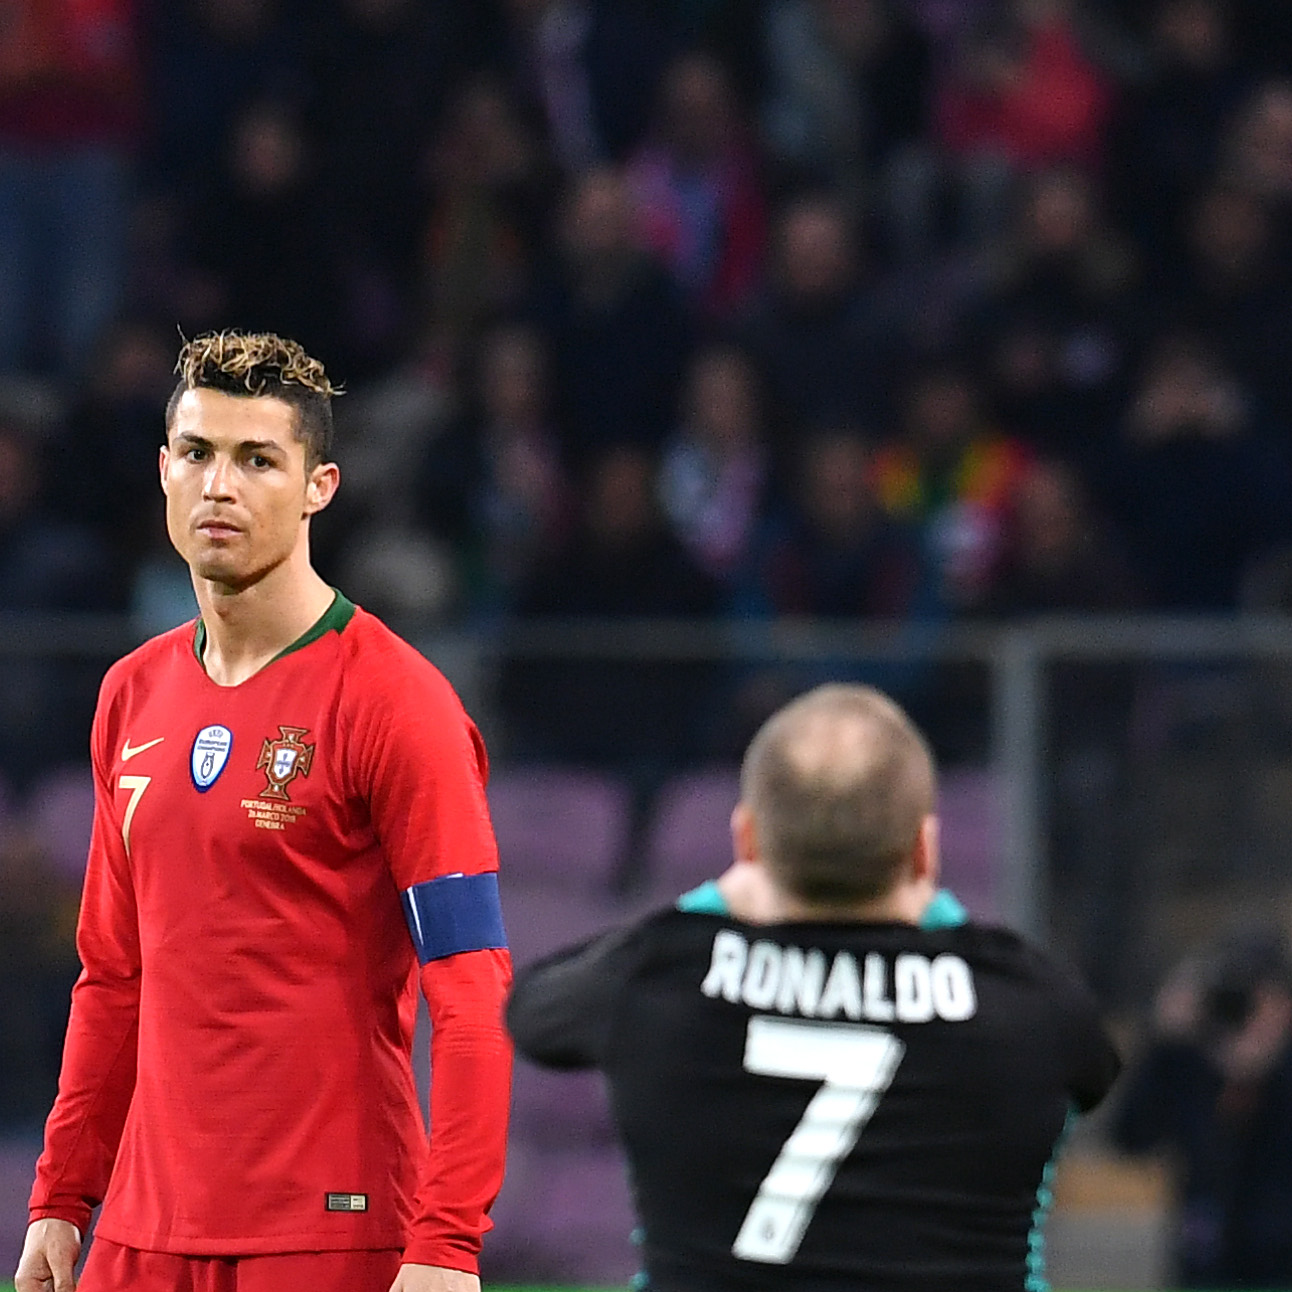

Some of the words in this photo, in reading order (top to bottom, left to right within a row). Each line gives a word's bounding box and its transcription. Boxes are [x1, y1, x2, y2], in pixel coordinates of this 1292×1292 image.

[118, 775, 152, 857] 7
[700, 928, 978, 1024] RONALDO
[731, 1014, 907, 1265] 7
